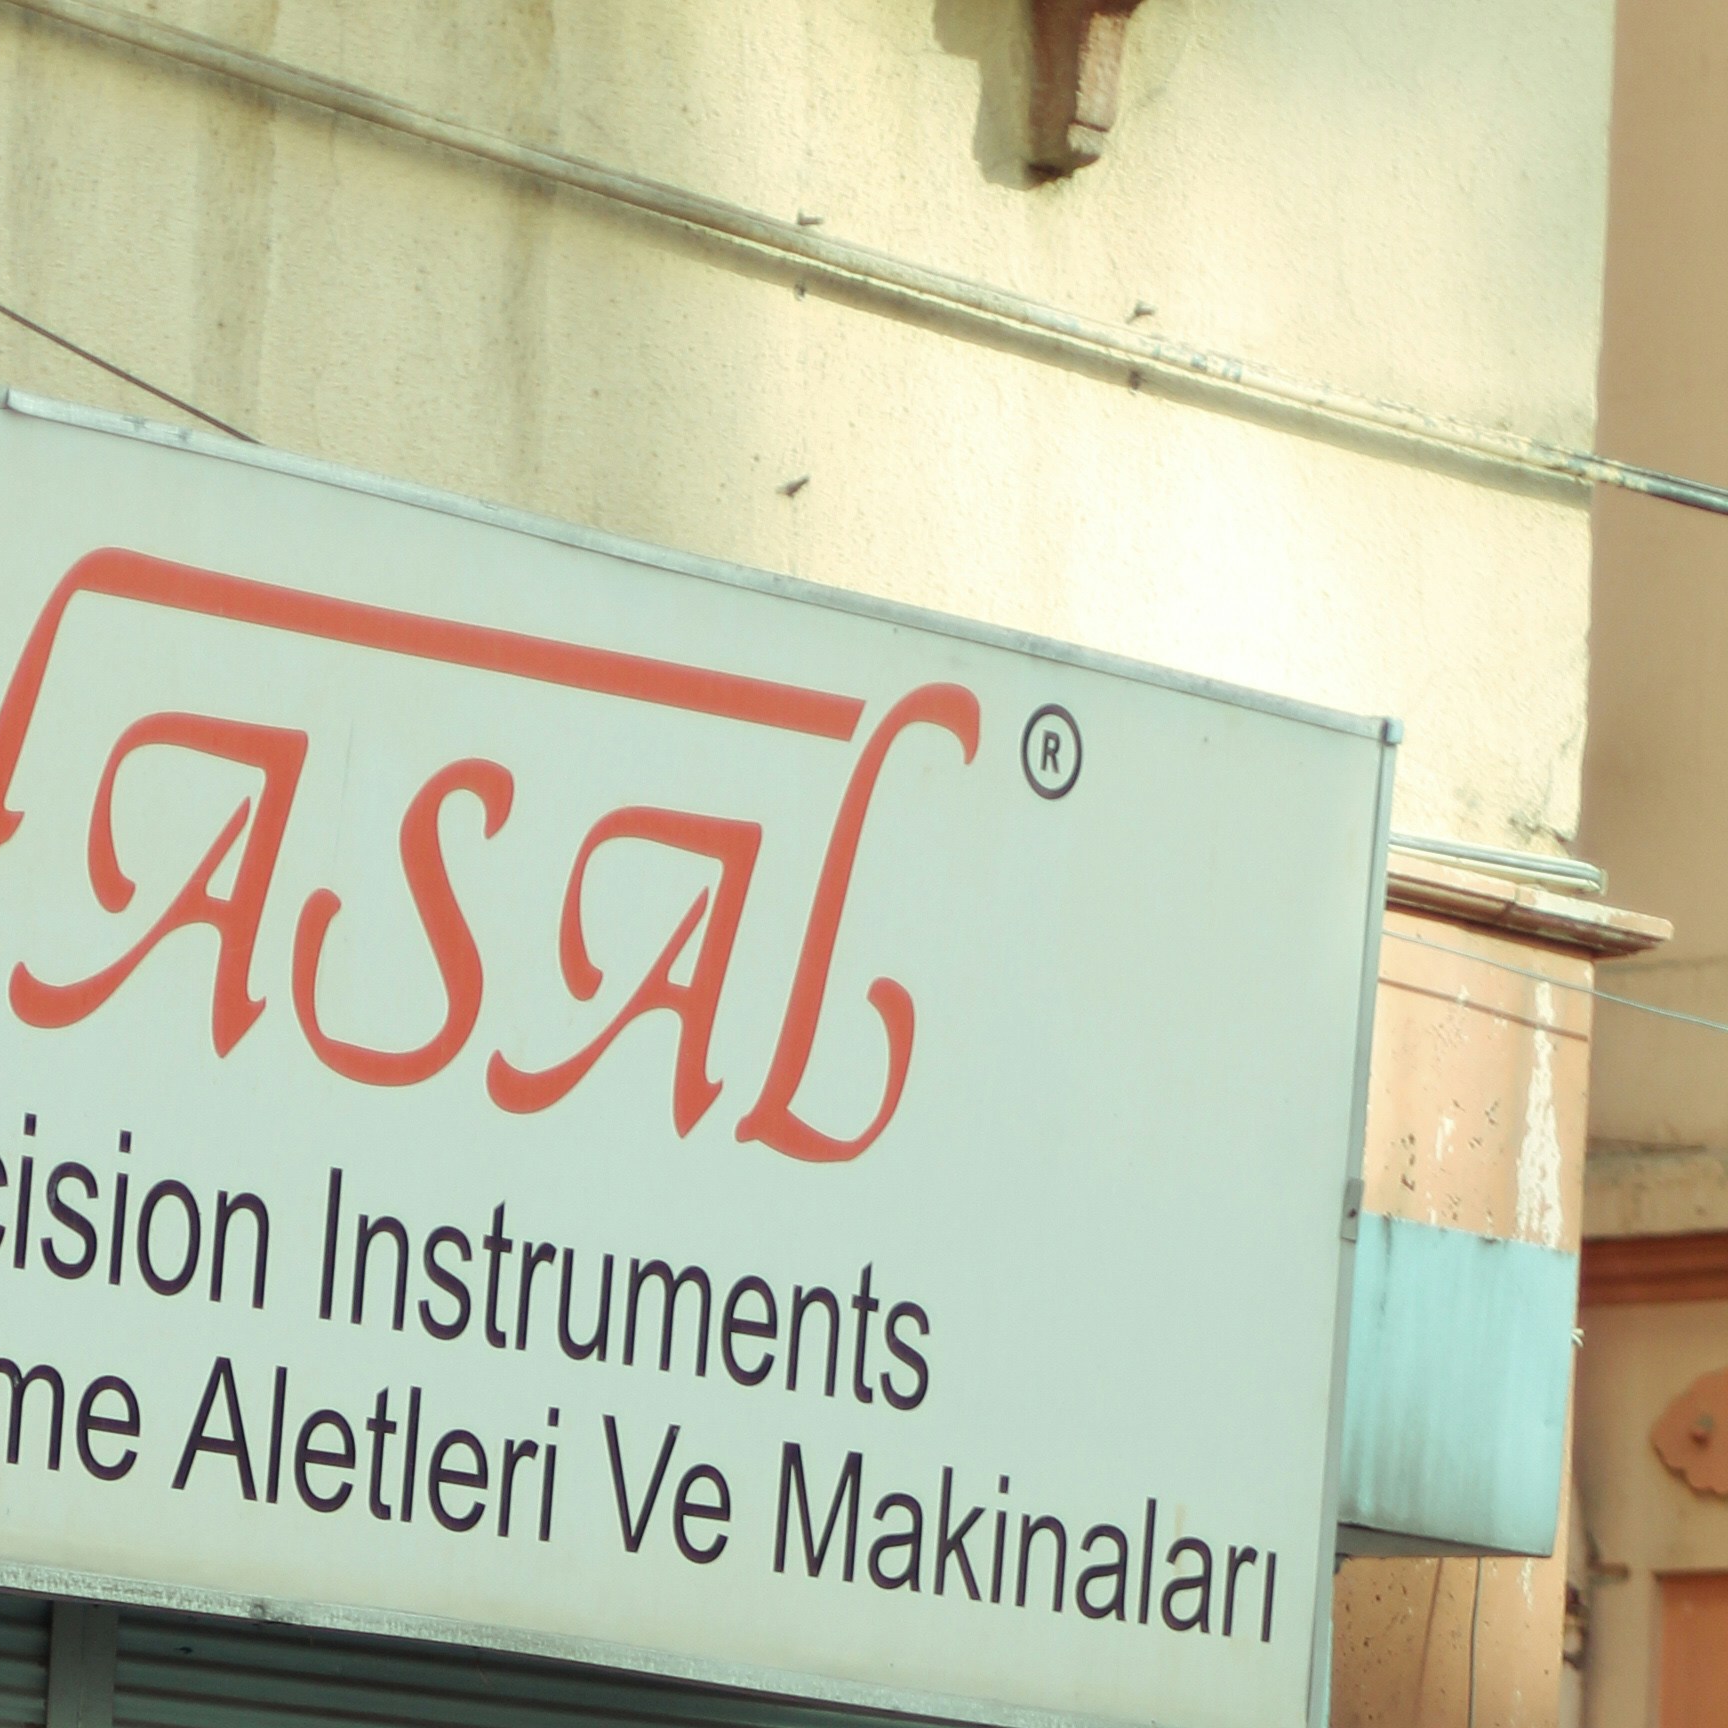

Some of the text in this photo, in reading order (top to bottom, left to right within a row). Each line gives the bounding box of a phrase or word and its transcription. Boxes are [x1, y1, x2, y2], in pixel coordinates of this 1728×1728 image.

[318, 1168, 931, 1412] Instruments
[171, 1355, 561, 1543] Aletleri
[603, 1414, 732, 1565] Ve
[773, 1441, 1278, 1644] Makinaları
